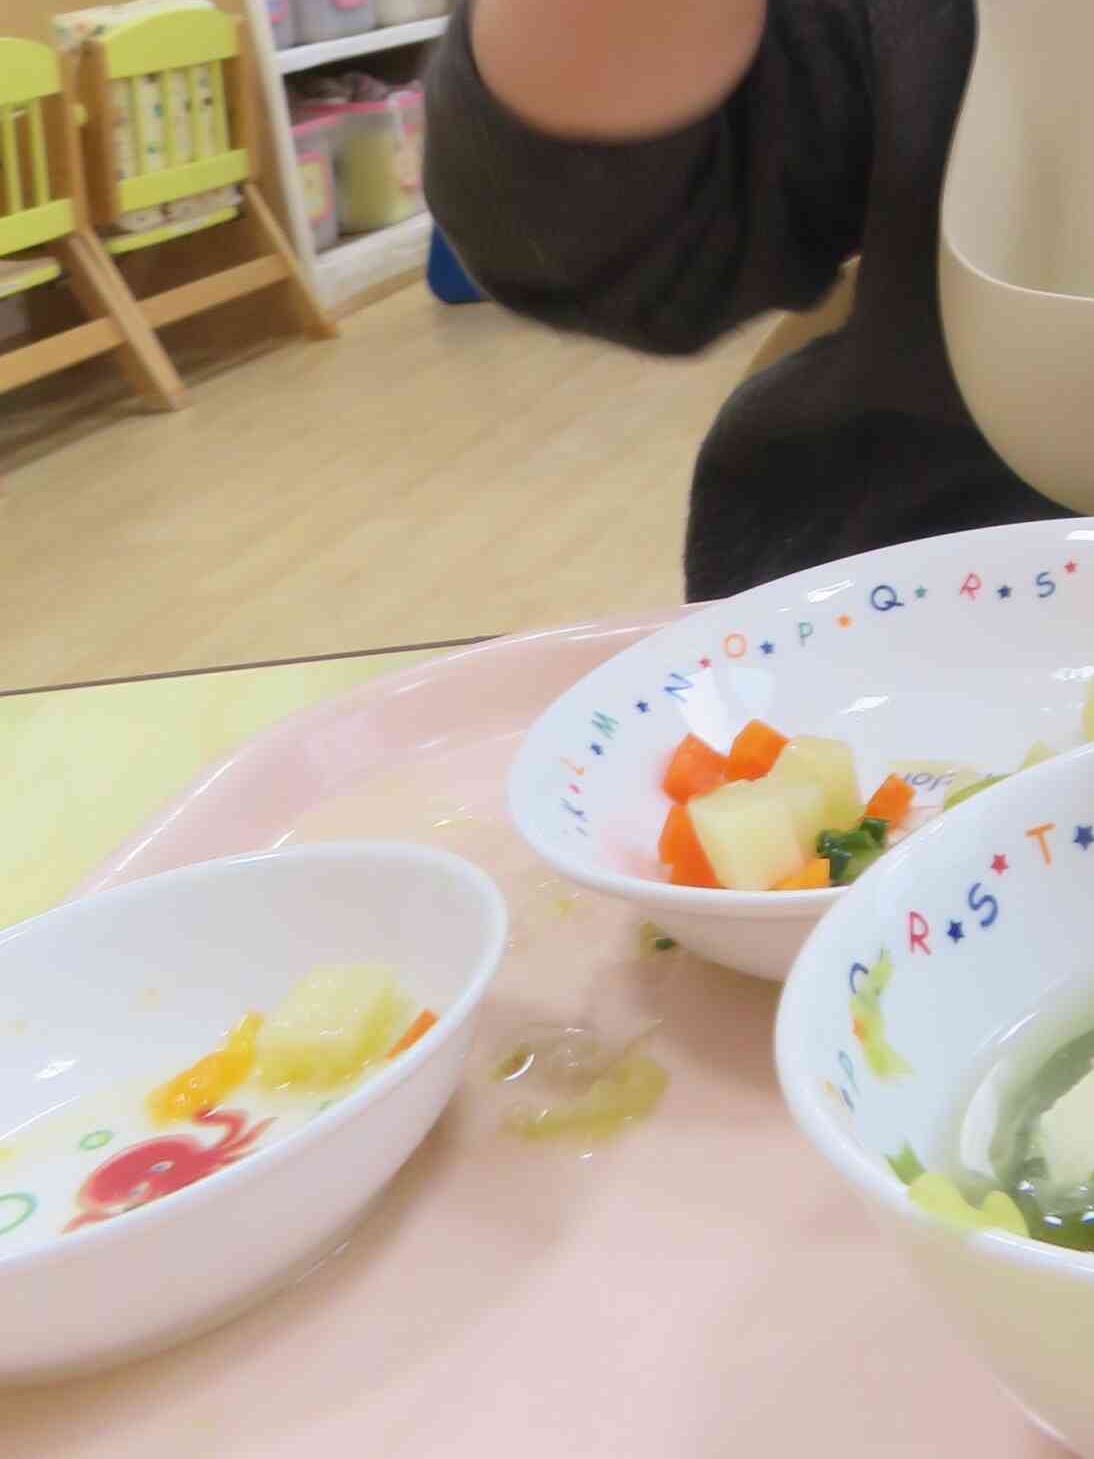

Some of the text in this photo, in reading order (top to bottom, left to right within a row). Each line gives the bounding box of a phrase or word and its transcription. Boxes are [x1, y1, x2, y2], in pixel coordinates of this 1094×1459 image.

[662, 672, 694, 702] N
[797, 621, 814, 647] P
[869, 584, 905, 612] Q
[959, 571, 983, 600] R
[1035, 571, 1057, 598] S
[907, 910, 932, 956] R
[967, 882, 999, 928] S
[1024, 822, 1057, 868] T
